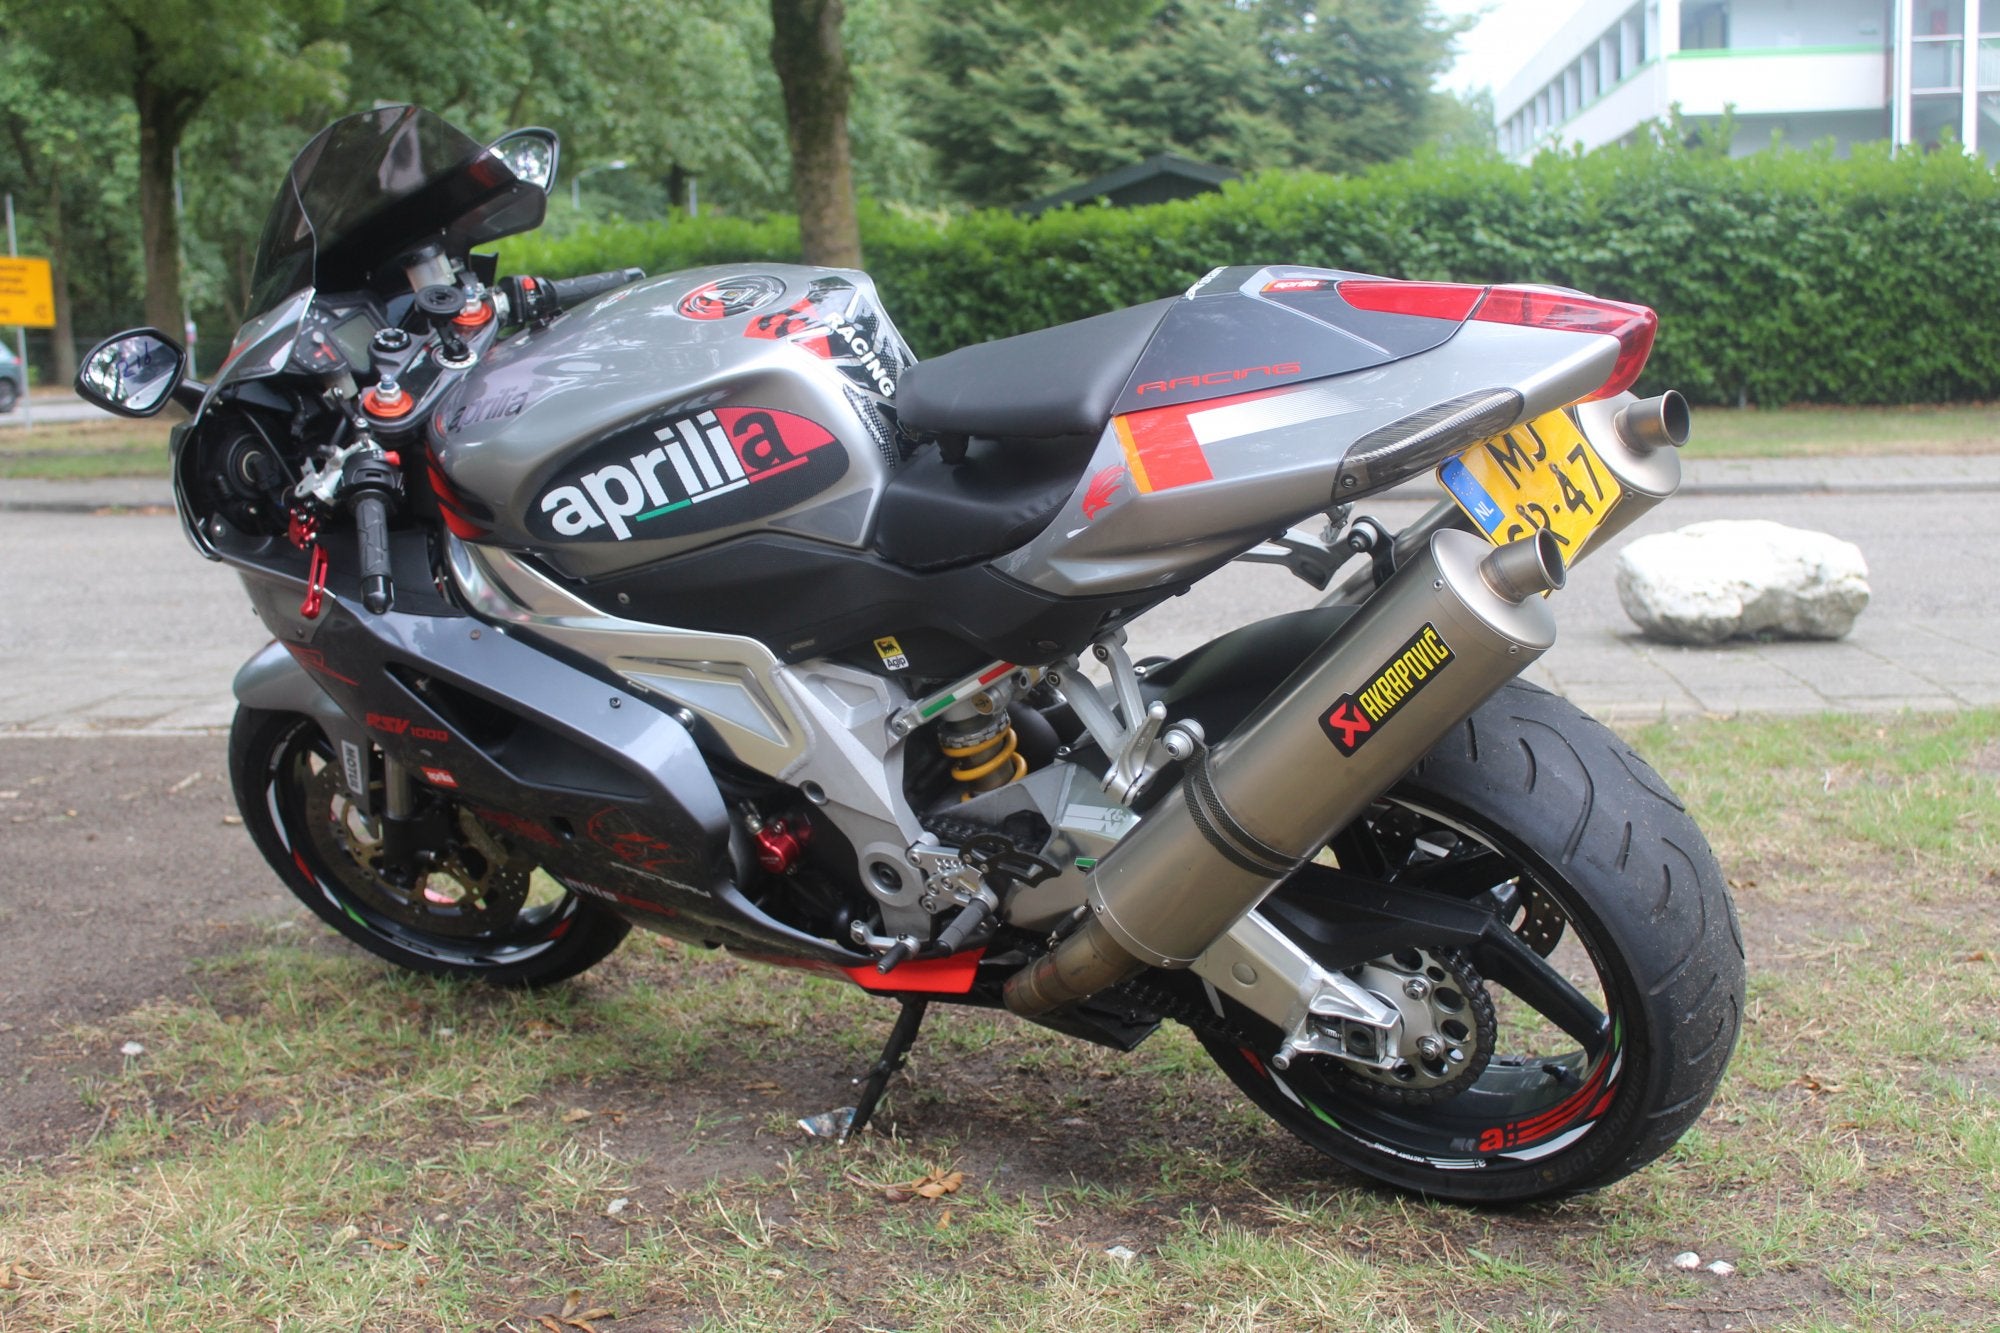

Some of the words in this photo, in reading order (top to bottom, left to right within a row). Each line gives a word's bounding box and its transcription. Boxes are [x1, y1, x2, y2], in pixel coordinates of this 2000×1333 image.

[825, 311, 897, 398] RACING
[1136, 361, 1302, 396] RACING
[540, 408, 798, 542] aprilia
[1484, 421, 1547, 490] MJ
[1473, 500, 1495, 522] NL
